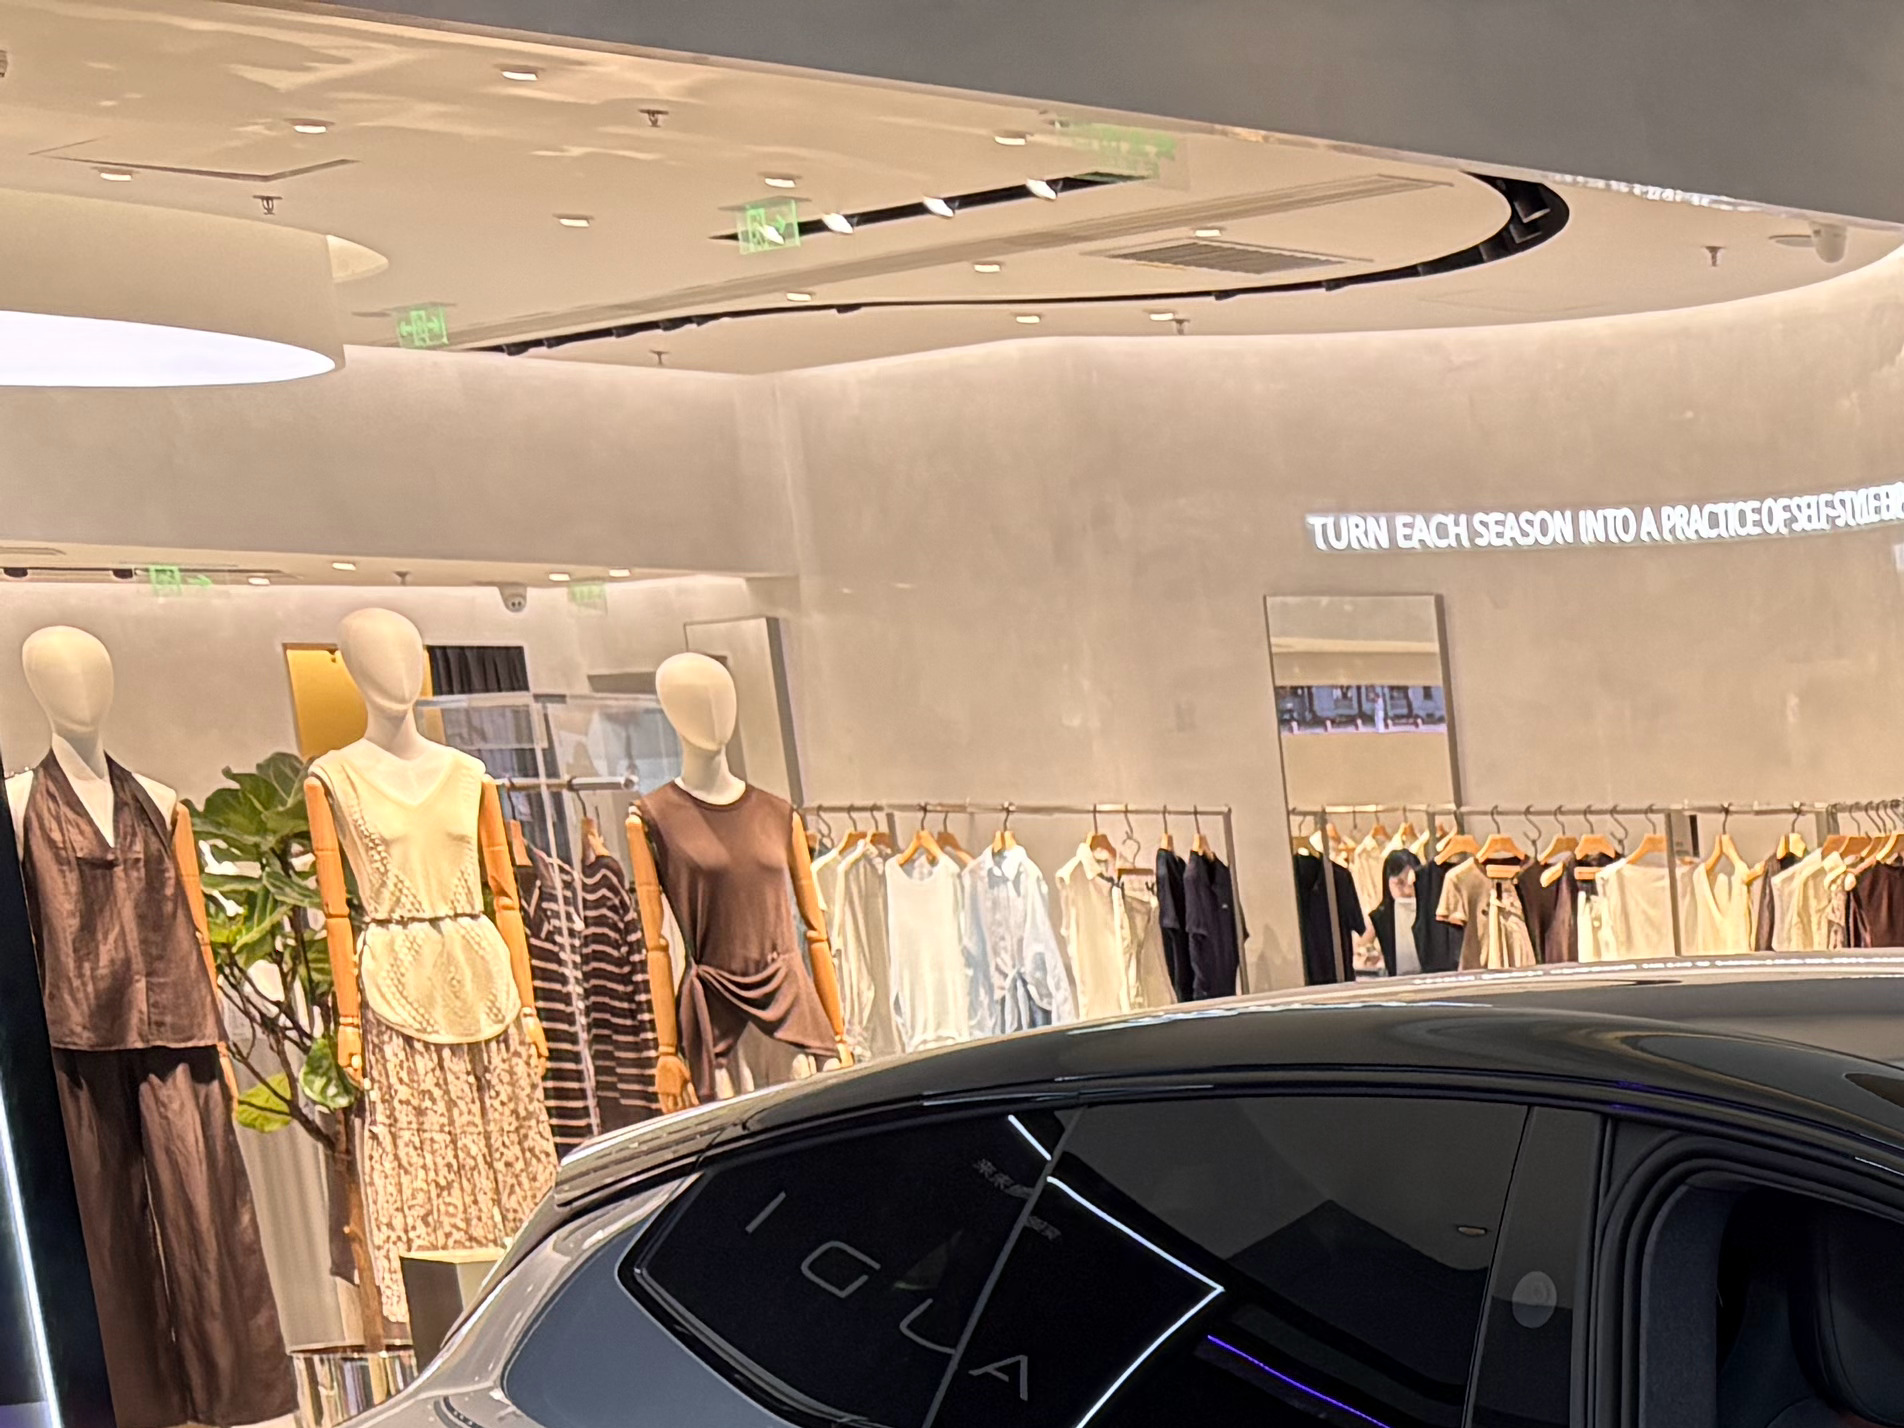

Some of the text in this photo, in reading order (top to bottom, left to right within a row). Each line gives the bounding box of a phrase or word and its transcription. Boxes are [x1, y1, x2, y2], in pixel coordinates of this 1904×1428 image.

[1307, 514, 1391, 551] TURN
[1395, 512, 1472, 549] EACH
[1473, 509, 1574, 548] SEASON
[1579, 506, 1638, 545] INTO
[1639, 505, 1662, 543] A
[1660, 500, 1762, 544] PRACTICE
[1761, 497, 1793, 537] OF
